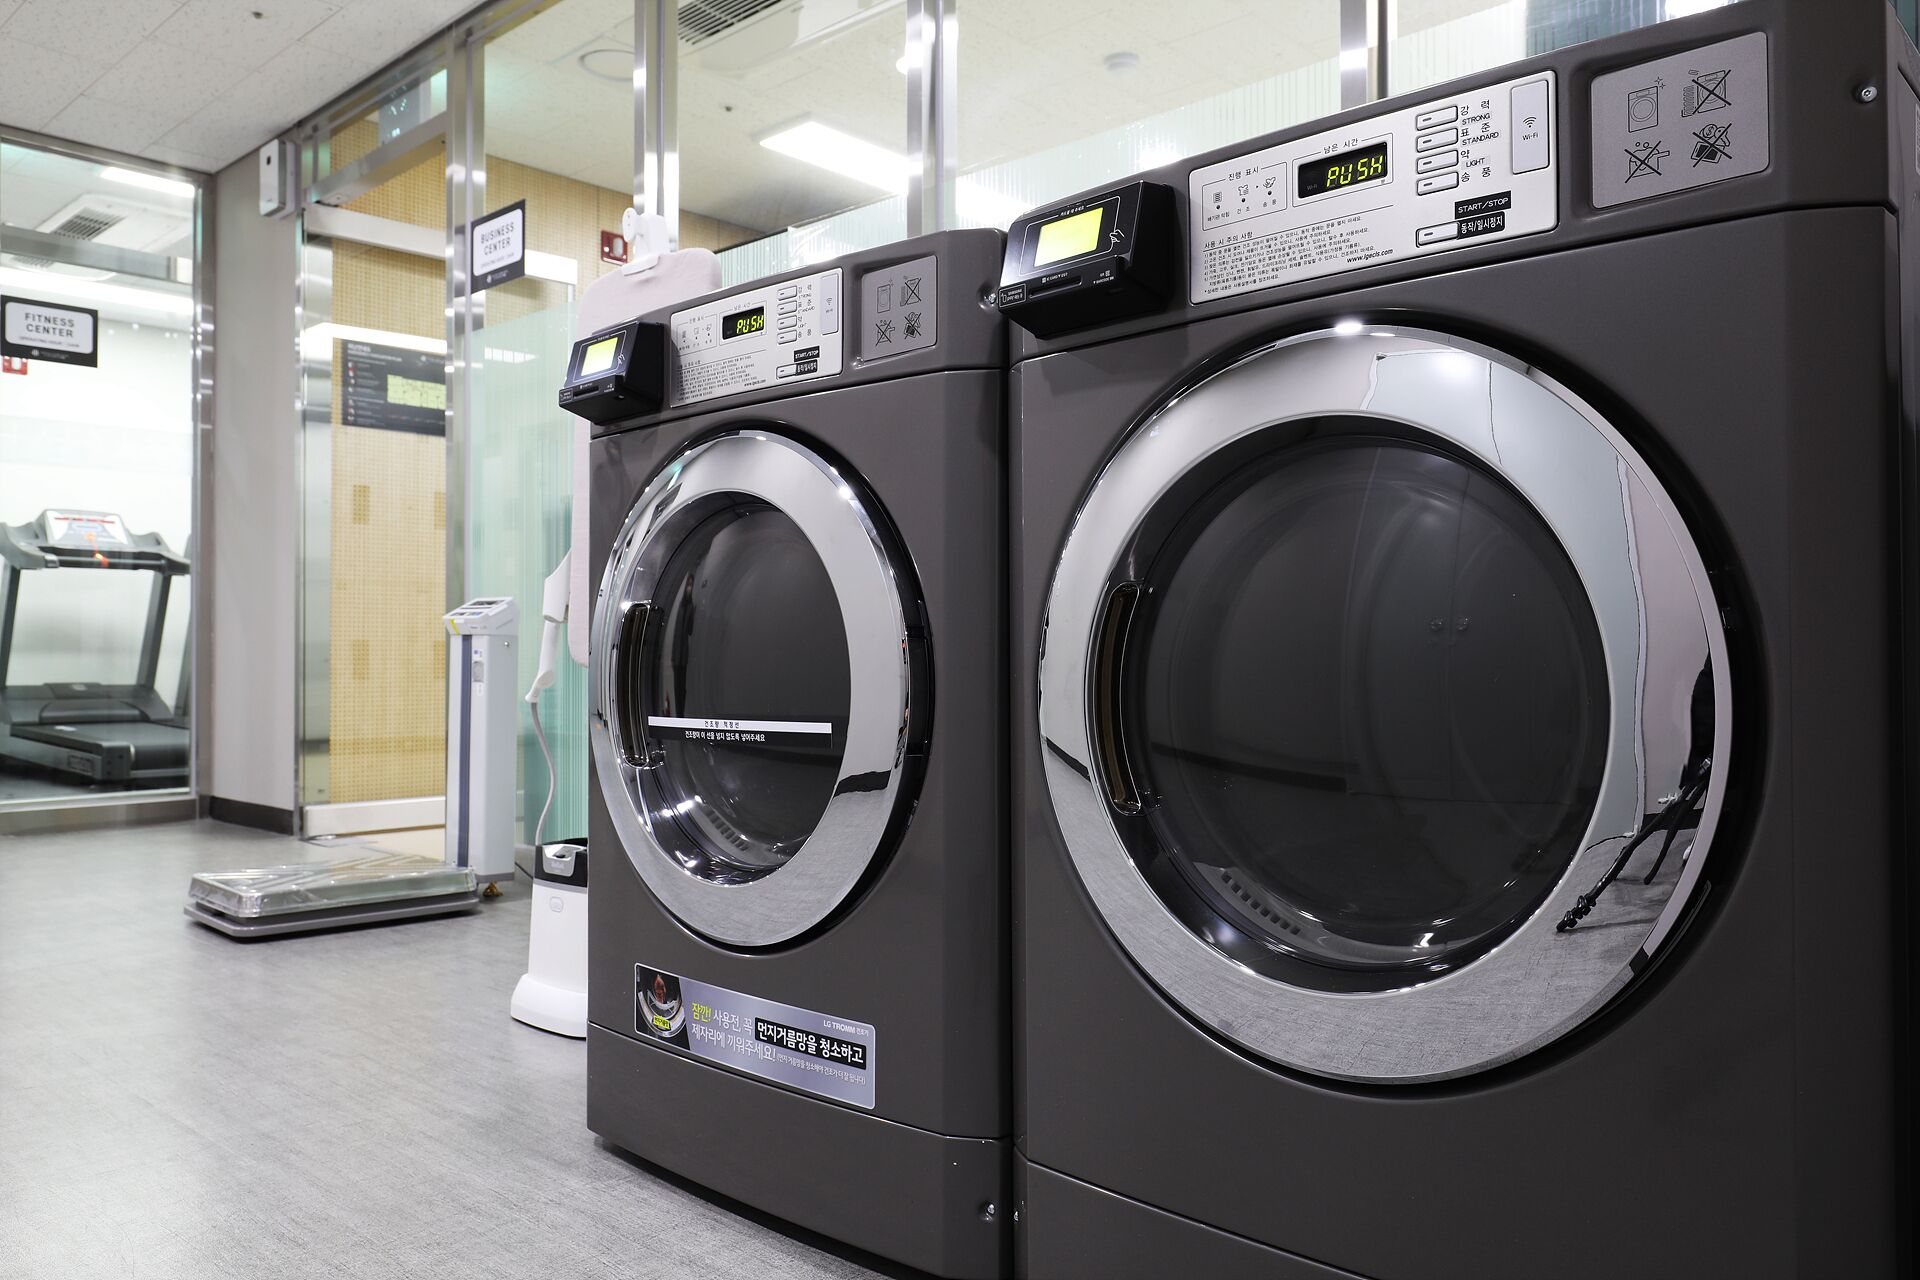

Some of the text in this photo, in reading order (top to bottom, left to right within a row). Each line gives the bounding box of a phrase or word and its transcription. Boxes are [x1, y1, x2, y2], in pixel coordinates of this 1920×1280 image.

[1462, 113, 1490, 125] STRONG
[1462, 132, 1499, 146] STANDARD
[1523, 132, 1538, 141] Wi-Fi
[1323, 138, 1358, 154] 남은 시간
[1460, 150, 1470, 159] 약
[1466, 158, 1485, 168] LIGHT
[1229, 166, 1258, 181] 진행 표시
[1326, 155, 1383, 188] PUSH
[1458, 197, 1508, 213] START/STOP
[1461, 215, 1503, 234] 동작/일시정지
[481, 222, 514, 244] BUSINESS
[484, 236, 510, 256] CENTER
[25, 312, 74, 328] FITNESS
[736, 315, 764, 334] PUSH
[26, 324, 73, 338] CENTER
[691, 1002, 864, 1064] 잠깐! 사용전, 꼭 먼지거름망을 청소하고
[824, 1020, 831, 1028] LG
[832, 1022, 856, 1034] TROMM
[691, 1023, 776, 1062] 제자리에 끼워주세요!
